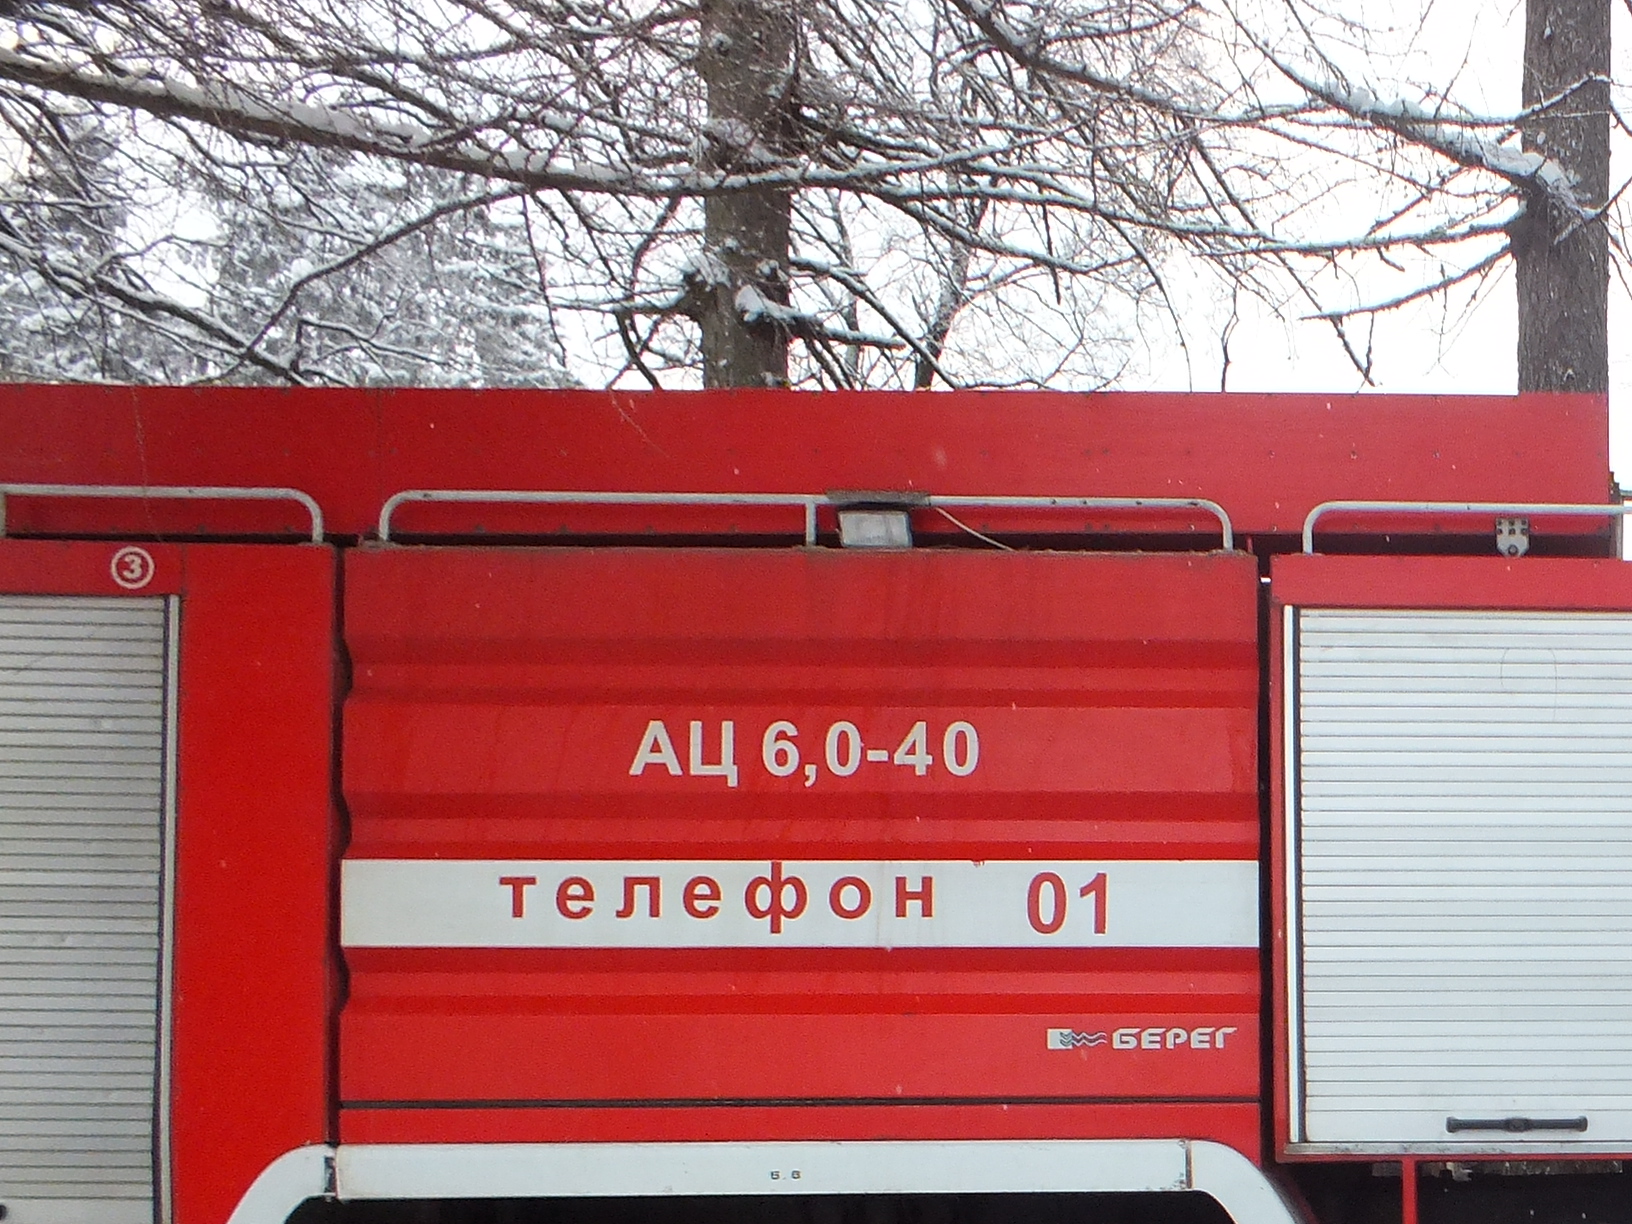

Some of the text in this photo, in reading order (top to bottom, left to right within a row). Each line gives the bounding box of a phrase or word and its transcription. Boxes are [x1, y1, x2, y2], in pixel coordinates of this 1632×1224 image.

[123, 554, 142, 579] 3
[629, 719, 980, 787] АЦ 6,0-40
[498, 861, 1108, 935] телефон 01
[1111, 1027, 1239, 1050] БЕРЕГ
